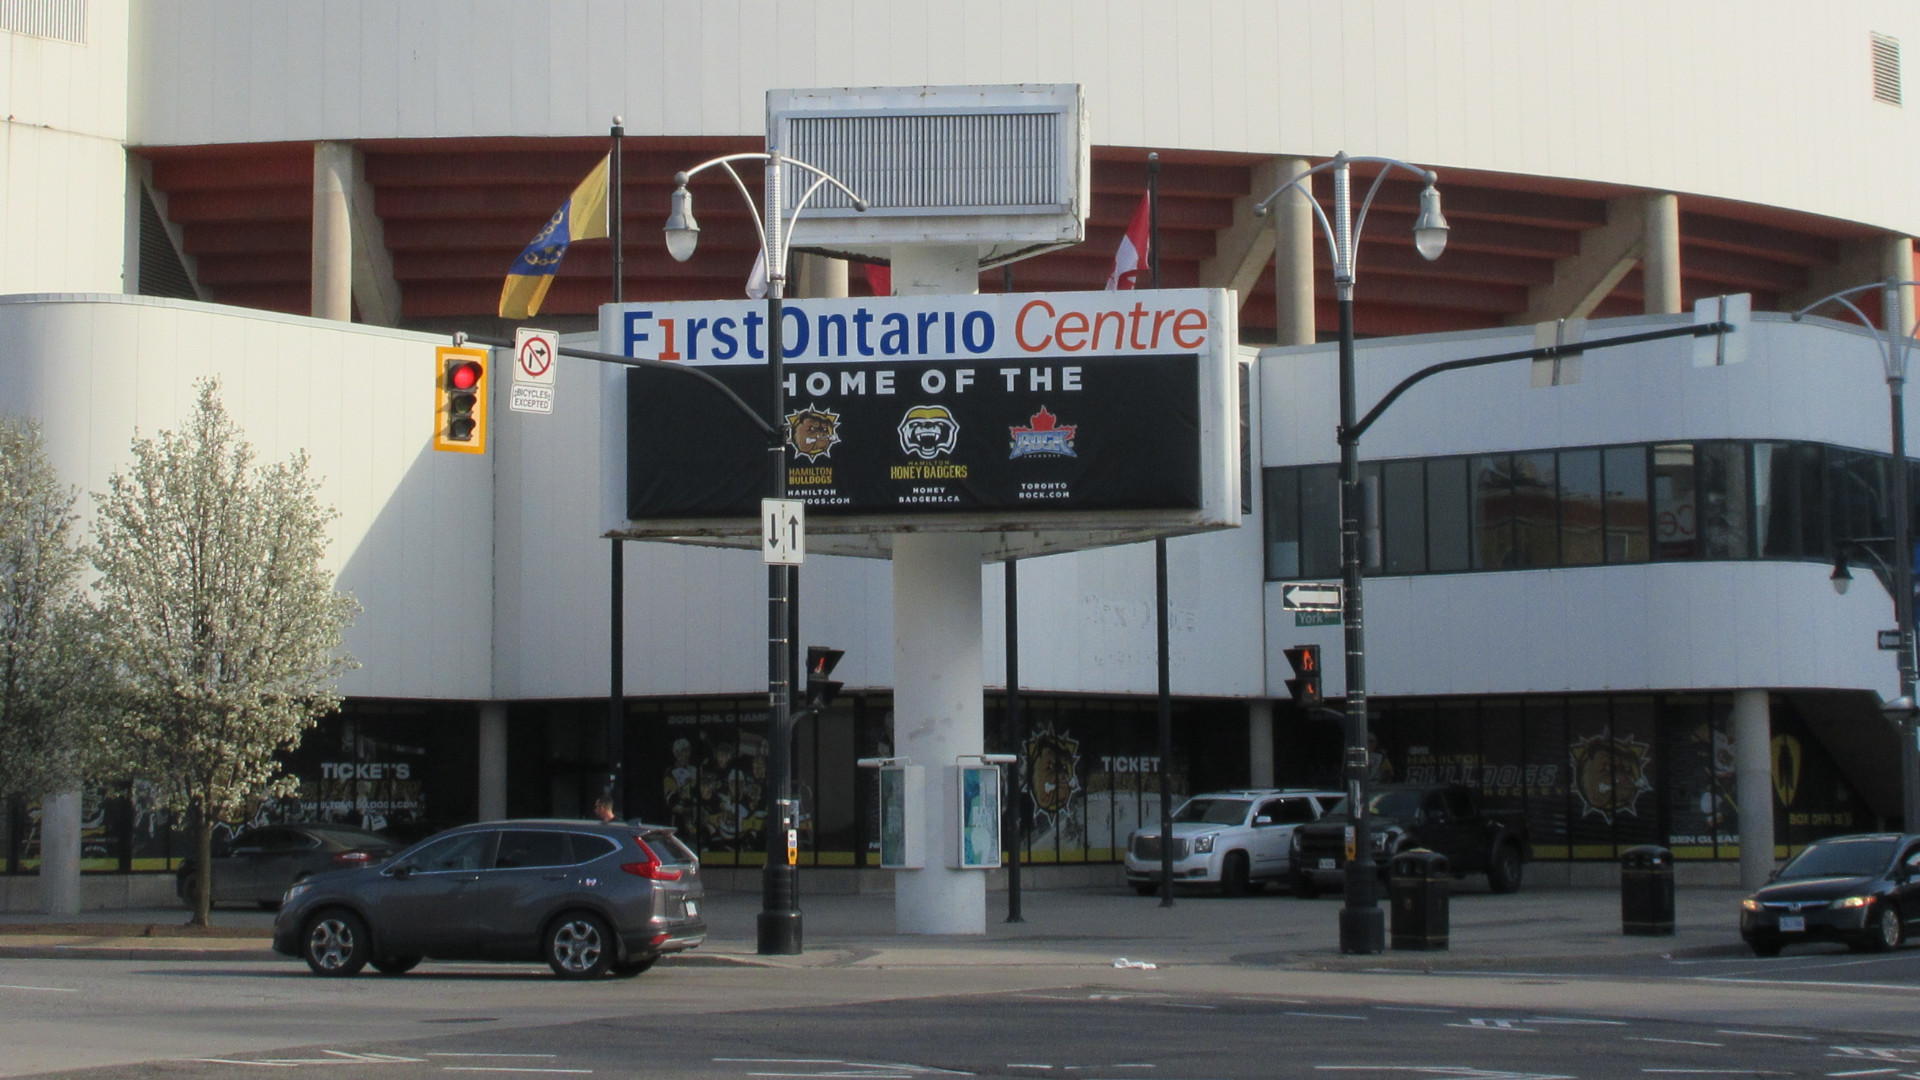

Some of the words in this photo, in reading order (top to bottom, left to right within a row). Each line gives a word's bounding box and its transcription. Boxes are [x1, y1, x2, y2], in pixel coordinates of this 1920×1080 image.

[1015, 299, 1208, 353] Centre
[782, 370, 896, 397] HOME
[921, 369, 975, 394] OF
[1000, 366, 1083, 392] THE
[517, 388, 549, 399] BICYCLES
[514, 397, 549, 409] EXCEPTED
[788, 467, 833, 477] HAMILTON
[890, 466, 922, 479] HONEY
[924, 465, 968, 479] BADGERS
[788, 475, 833, 485] BULLDOGS
[1021, 482, 1067, 490] TORONTO
[787, 488, 837, 497] HAMILTON
[1019, 491, 1070, 499] ROCK.COM
[803, 497, 851, 505] OGS.COM
[898, 495, 961, 503] BADGERS.CA
[1298, 611, 1324, 625] York
[1101, 755, 1161, 772] TICKET
[320, 762, 411, 780] TICKETS
[1788, 812, 1810, 825] BOX
[1669, 835, 1696, 845] BEN
